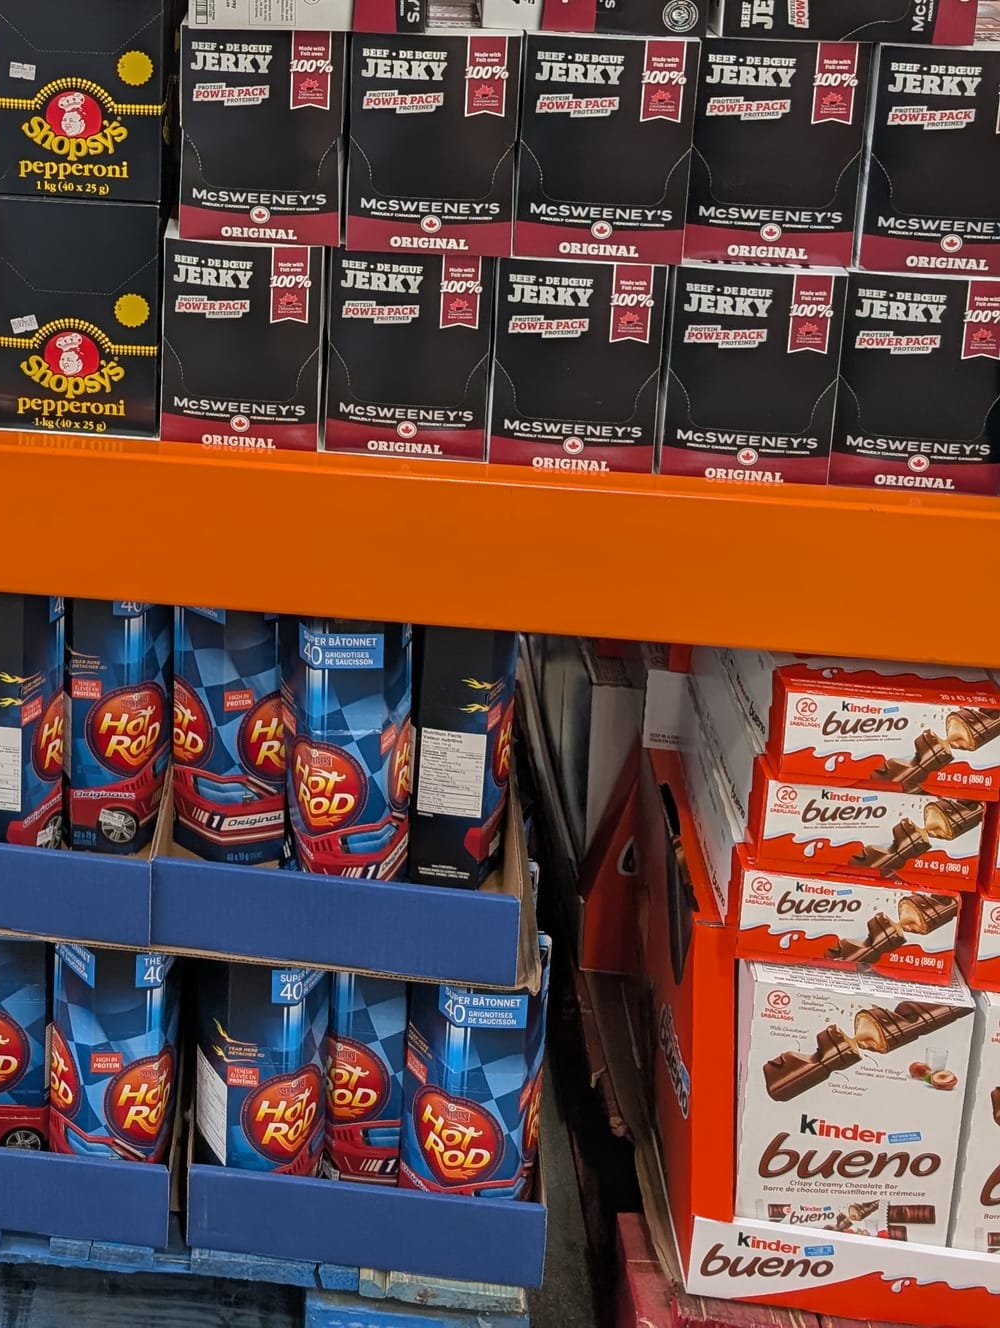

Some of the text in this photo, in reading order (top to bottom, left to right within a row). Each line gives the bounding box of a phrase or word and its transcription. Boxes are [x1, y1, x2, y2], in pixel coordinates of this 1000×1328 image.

[191, 41, 272, 54] BEEF DE BŒUF
[190, 52, 273, 75] JERKY
[289, 59, 333, 73] 100%
[195, 87, 267, 99] POWER PACK
[221, 226, 297, 241] ORIGINAL
[800, 701, 818, 713] 20
[822, 710, 909, 736] bueno
[937, 772, 946, 781] 20
[953, 774, 961, 782] 43
[962, 776, 967, 784] g
[968, 774, 983, 785] (860
[984, 776, 992, 786] g)
[472, 996, 521, 1008] BÂTONNET
[468, 1011, 513, 1019] GRIGNOTISES
[758, 1132, 942, 1179] bueno
[815, 1181, 842, 1189] Creamy
[700, 1243, 834, 1278] bueno
